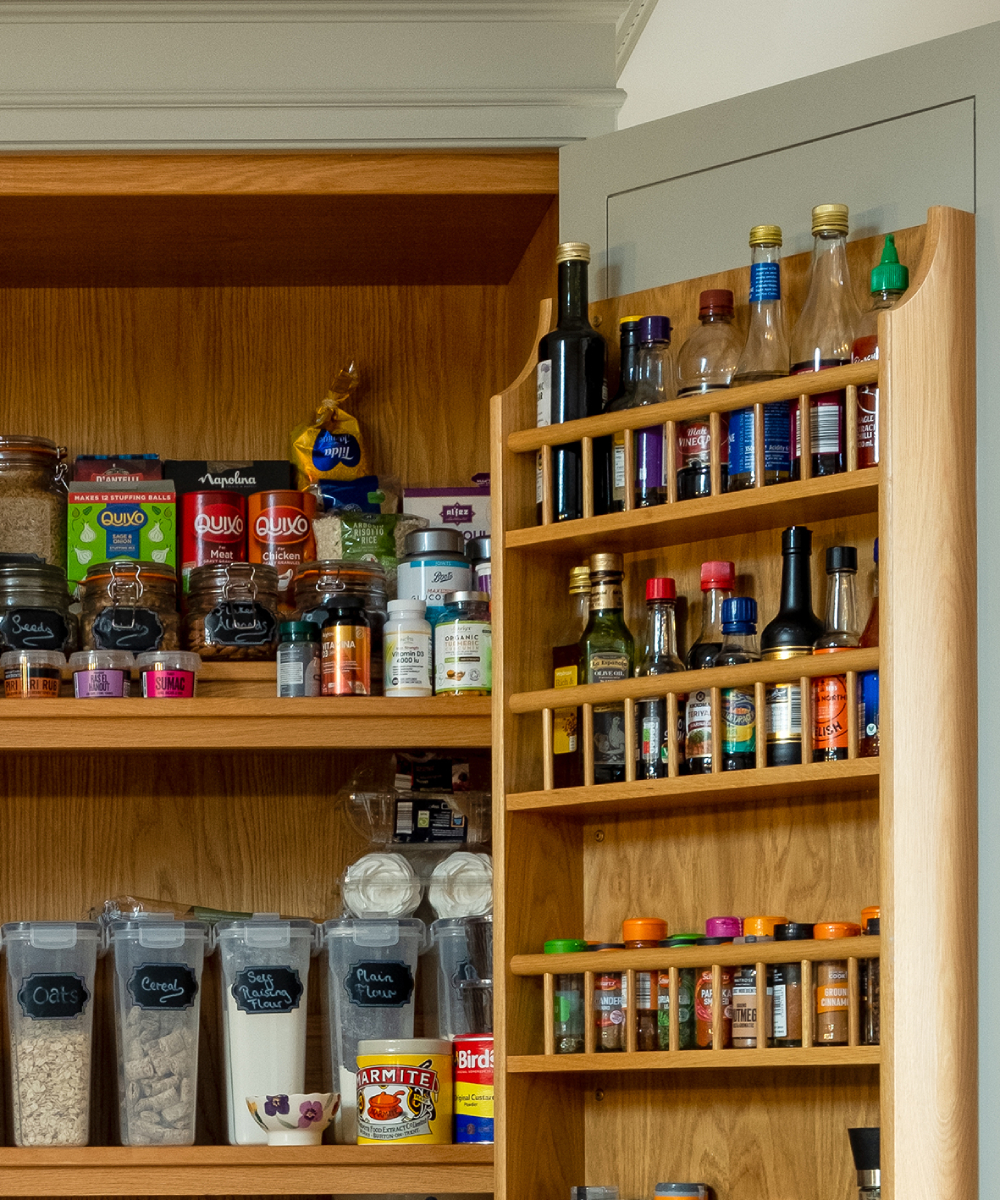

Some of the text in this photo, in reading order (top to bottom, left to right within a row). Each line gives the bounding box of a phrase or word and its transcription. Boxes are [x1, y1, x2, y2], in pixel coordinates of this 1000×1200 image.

[688, 426, 708, 436] Malt
[679, 436, 711, 448] VINEGA
[324, 446, 354, 460] Tilda
[769, 444, 786, 452] Acidity
[198, 470, 256, 488] Napolina
[101, 510, 144, 526] QUIXO
[194, 513, 244, 536] QUIXO
[255, 515, 308, 536] QUIXO
[361, 536, 378, 544] RICE
[210, 550, 234, 560] Meat
[262, 551, 300, 561] Chicken
[431, 571, 454, 583] Boots
[12, 614, 54, 638] Seeds
[444, 634, 479, 642] ORGANIC
[416, 650, 424, 658] D3
[90, 674, 108, 682] RAS EL
[556, 677, 568, 686] Rich
[43, 680, 58, 692] RUB
[89, 682, 110, 692] HANOUT
[156, 678, 185, 690] SUMAC
[822, 694, 846, 702] NORTH
[688, 710, 711, 718] TERIYA
[815, 721, 842, 736] ELISH
[248, 971, 274, 990] Self
[356, 968, 394, 983] Plain
[140, 976, 185, 996] Cereal
[32, 986, 78, 1005] Oats
[238, 985, 292, 1004] Raising
[355, 984, 397, 999] Flour
[701, 988, 732, 998] PAPKA
[824, 988, 848, 997] GROUN
[248, 1000, 283, 1010] Flour
[601, 996, 622, 1006] ANDER
[704, 998, 730, 1006] SMED
[821, 998, 848, 1007] CINNAM
[382, 1124, 406, 1133] EXTRACT
